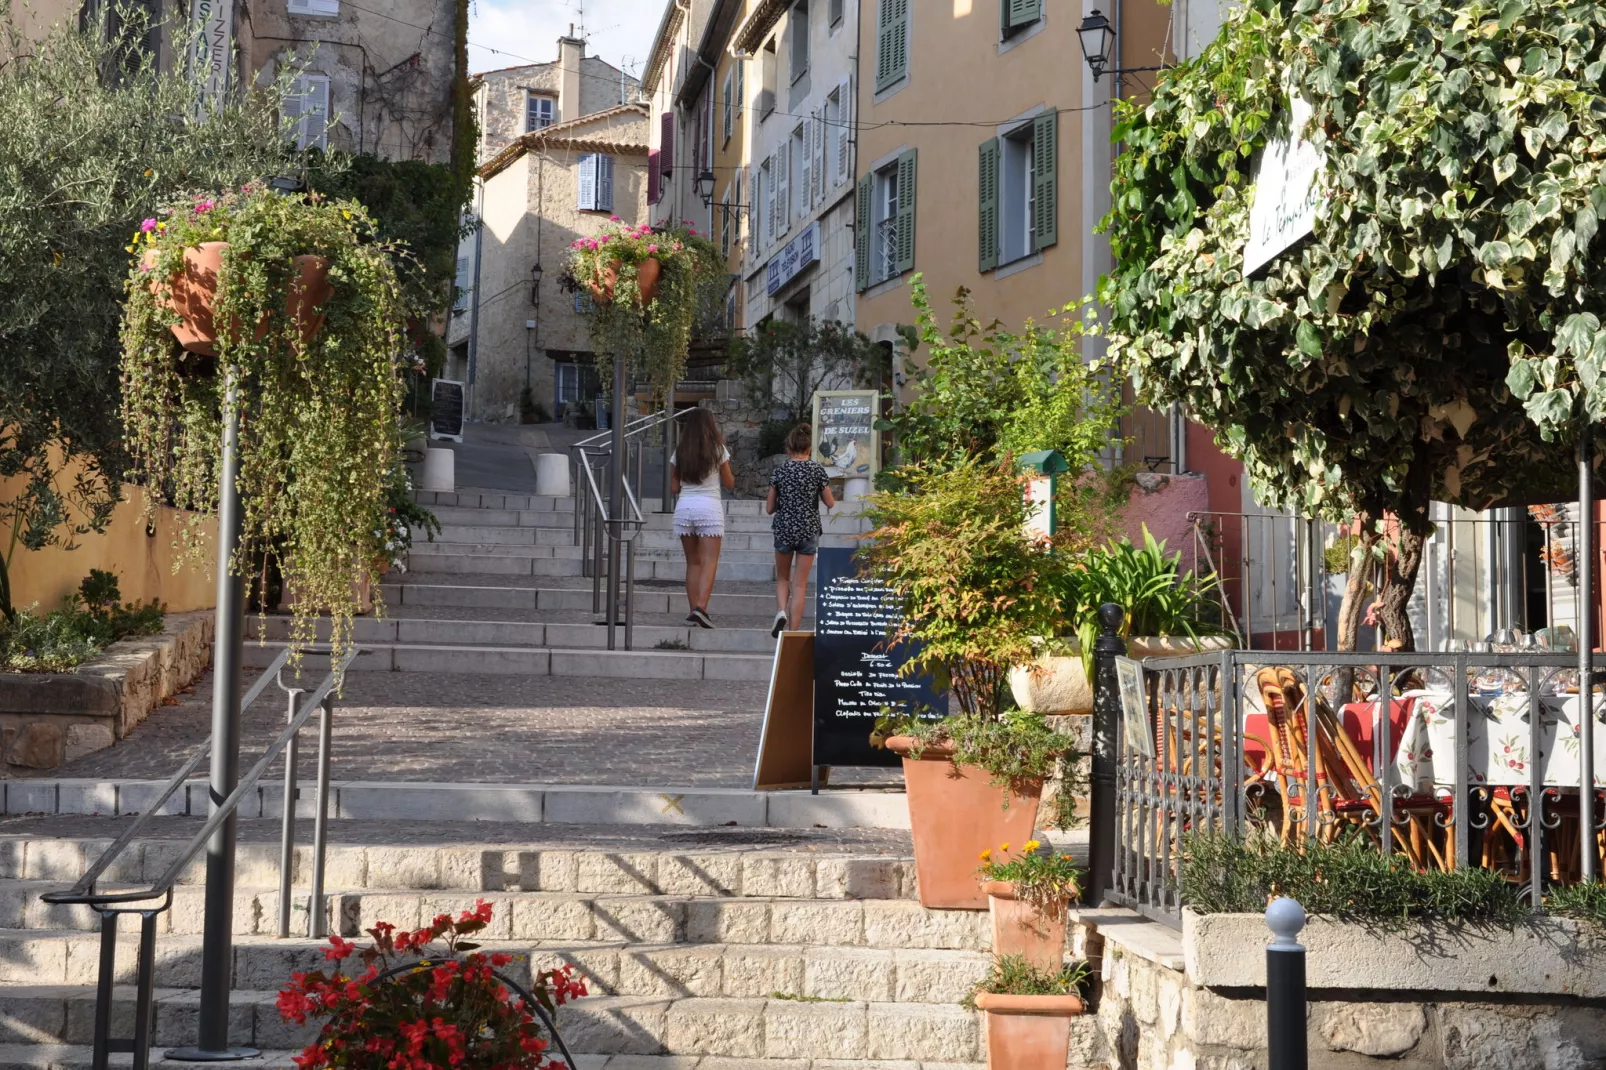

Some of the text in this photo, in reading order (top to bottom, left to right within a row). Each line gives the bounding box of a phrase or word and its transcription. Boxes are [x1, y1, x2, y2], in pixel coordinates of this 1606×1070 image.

[841, 398, 859, 406] LES
[820, 406, 870, 415] GRENIERS
[838, 426, 870, 434] SUZEL
